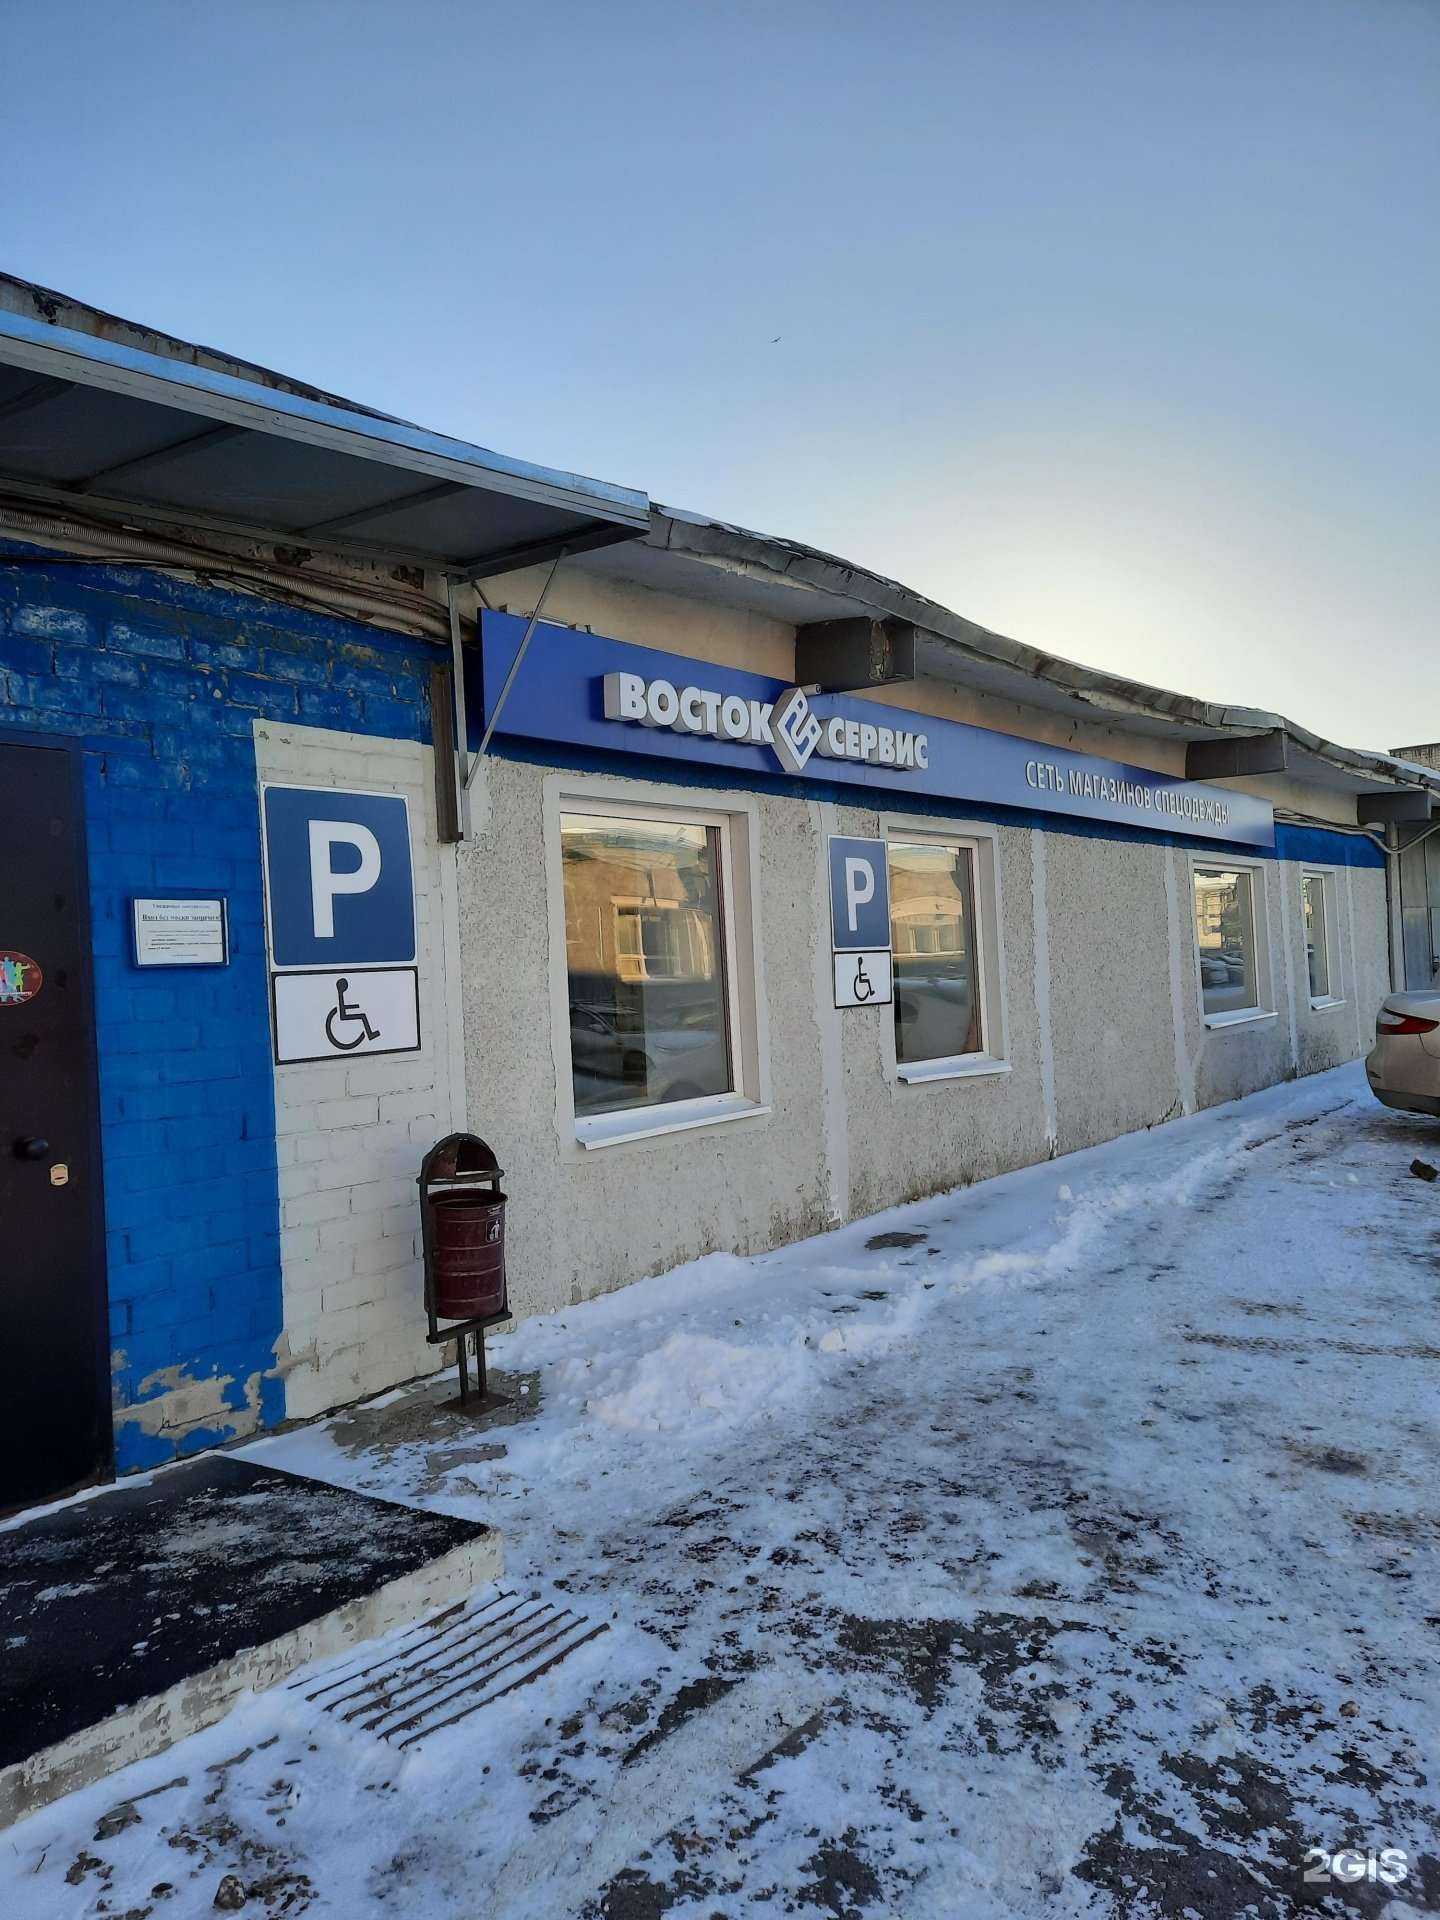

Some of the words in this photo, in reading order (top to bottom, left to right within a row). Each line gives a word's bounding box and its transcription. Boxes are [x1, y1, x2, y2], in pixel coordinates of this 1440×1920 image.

[606, 672, 775, 745] ВОСТОК
[821, 717, 929, 769] СЕРВИС
[1025, 760, 1064, 793] СЕТЬ
[1068, 769, 1151, 809] МАГАЗИНОВ
[1153, 788, 1230, 828] СПЕЦОДЕЖДЫ
